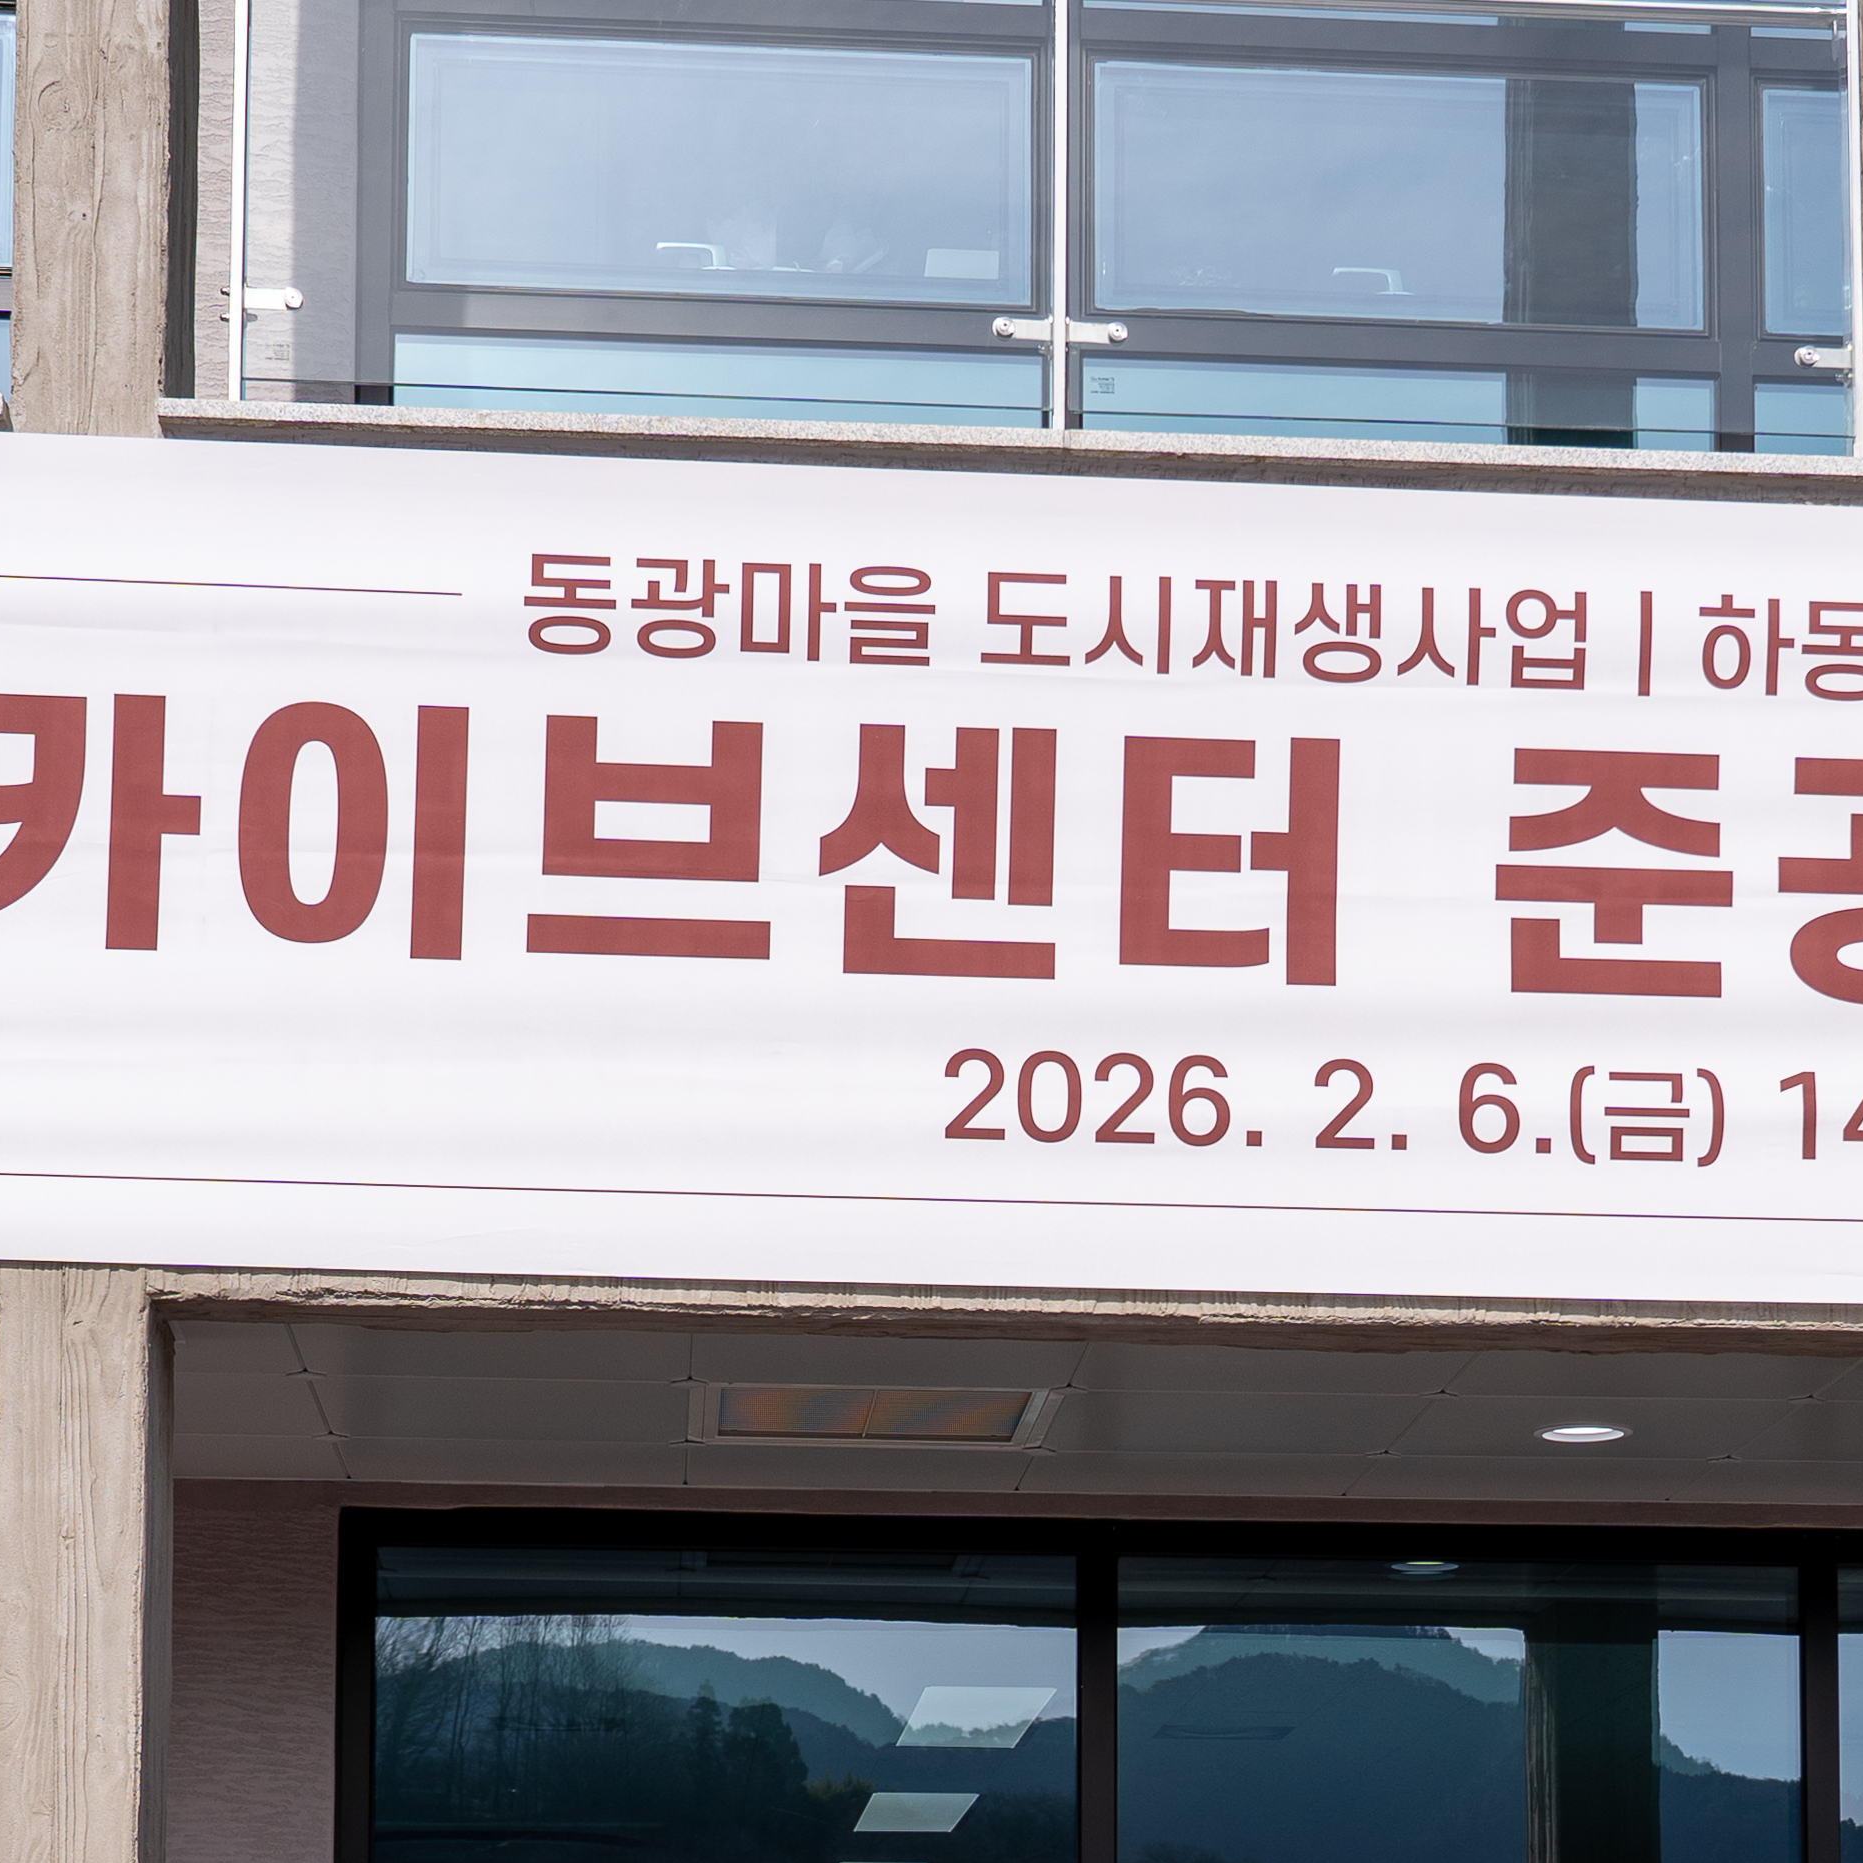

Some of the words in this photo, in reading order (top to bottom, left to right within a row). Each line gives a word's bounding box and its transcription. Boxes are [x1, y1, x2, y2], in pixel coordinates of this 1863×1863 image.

[524, 553, 935, 666] 동광마을
[980, 571, 1587, 690] 도시재생사업
[944, 1048, 1263, 1147] 2026.
[1314, 1059, 1408, 1151] 2.
[1458, 1062, 1725, 1167] 6.(금)
